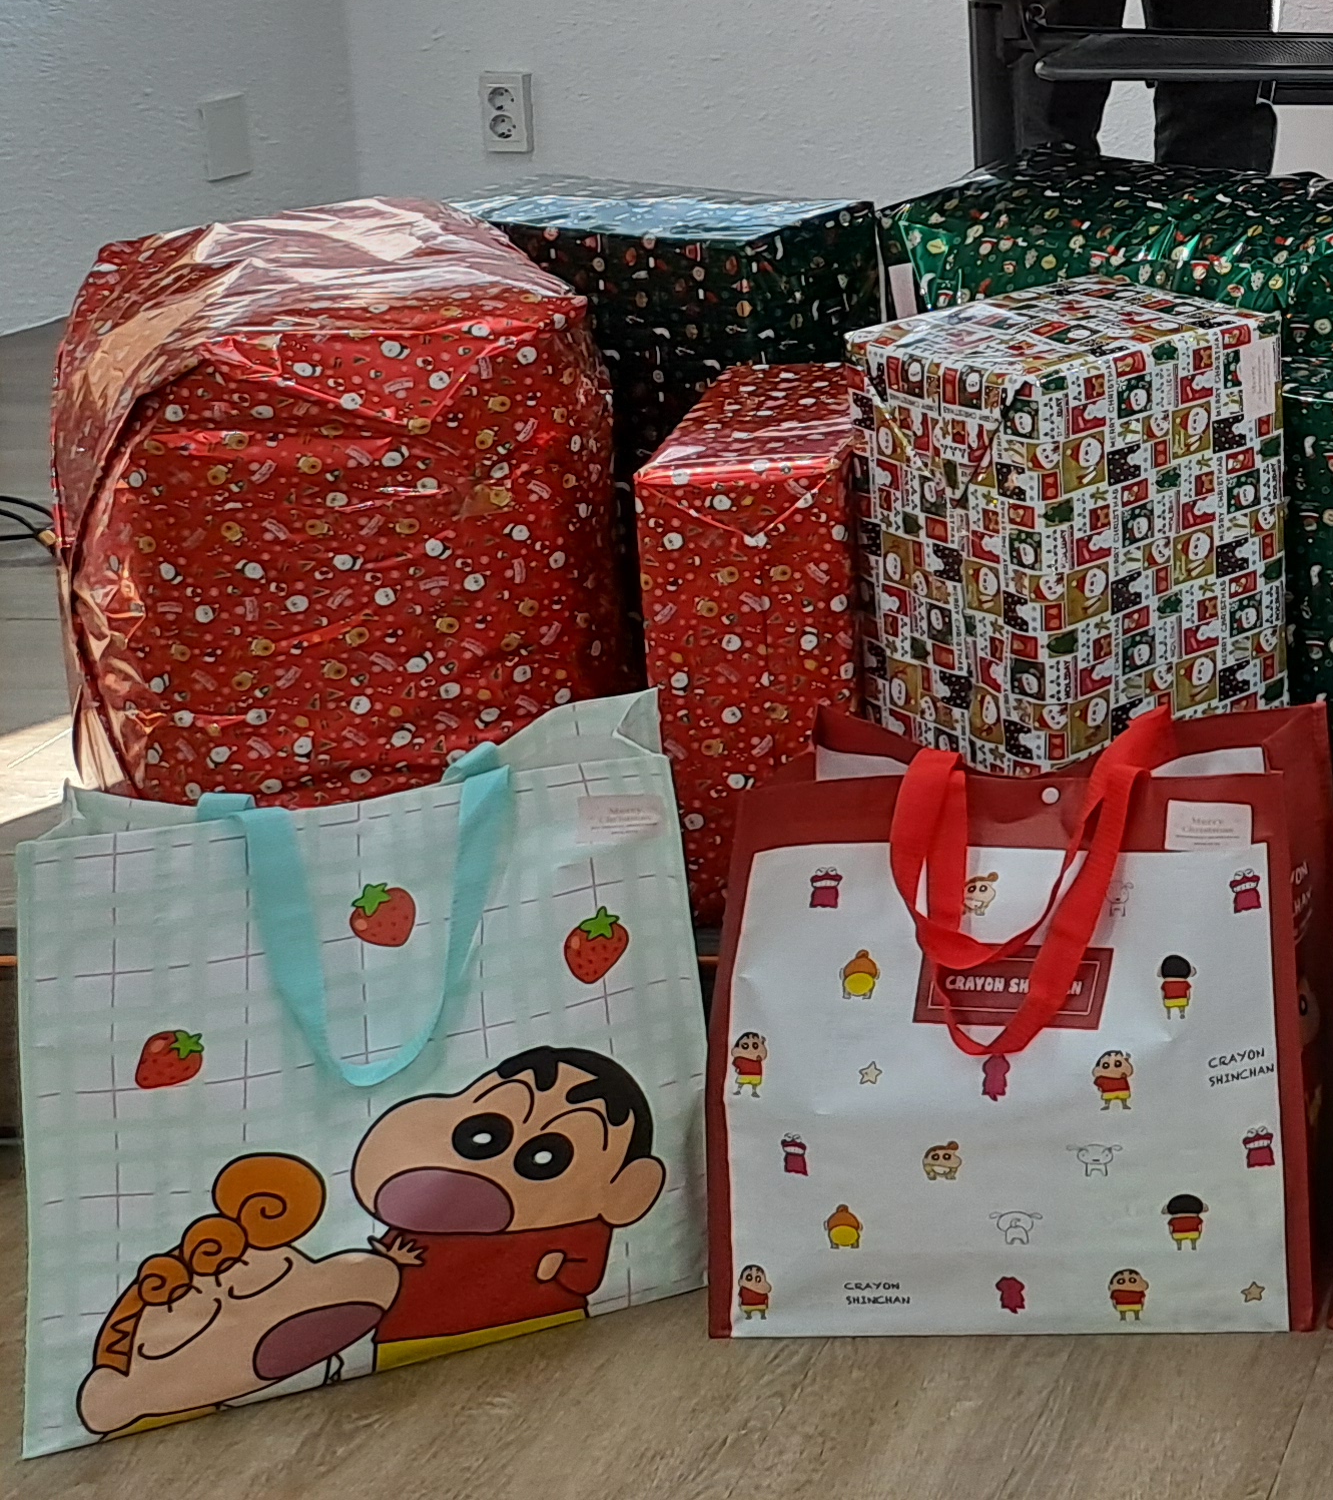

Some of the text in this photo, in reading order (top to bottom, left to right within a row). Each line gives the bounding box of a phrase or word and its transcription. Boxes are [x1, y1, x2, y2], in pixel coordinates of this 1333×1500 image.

[945, 975, 1005, 992] CRAYON
[1208, 1047, 1265, 1069] CRAYON
[1208, 1064, 1274, 1087] SHINCHAN
[843, 1282, 900, 1291] CRAYON
[845, 1295, 911, 1305] SHINCHAN
